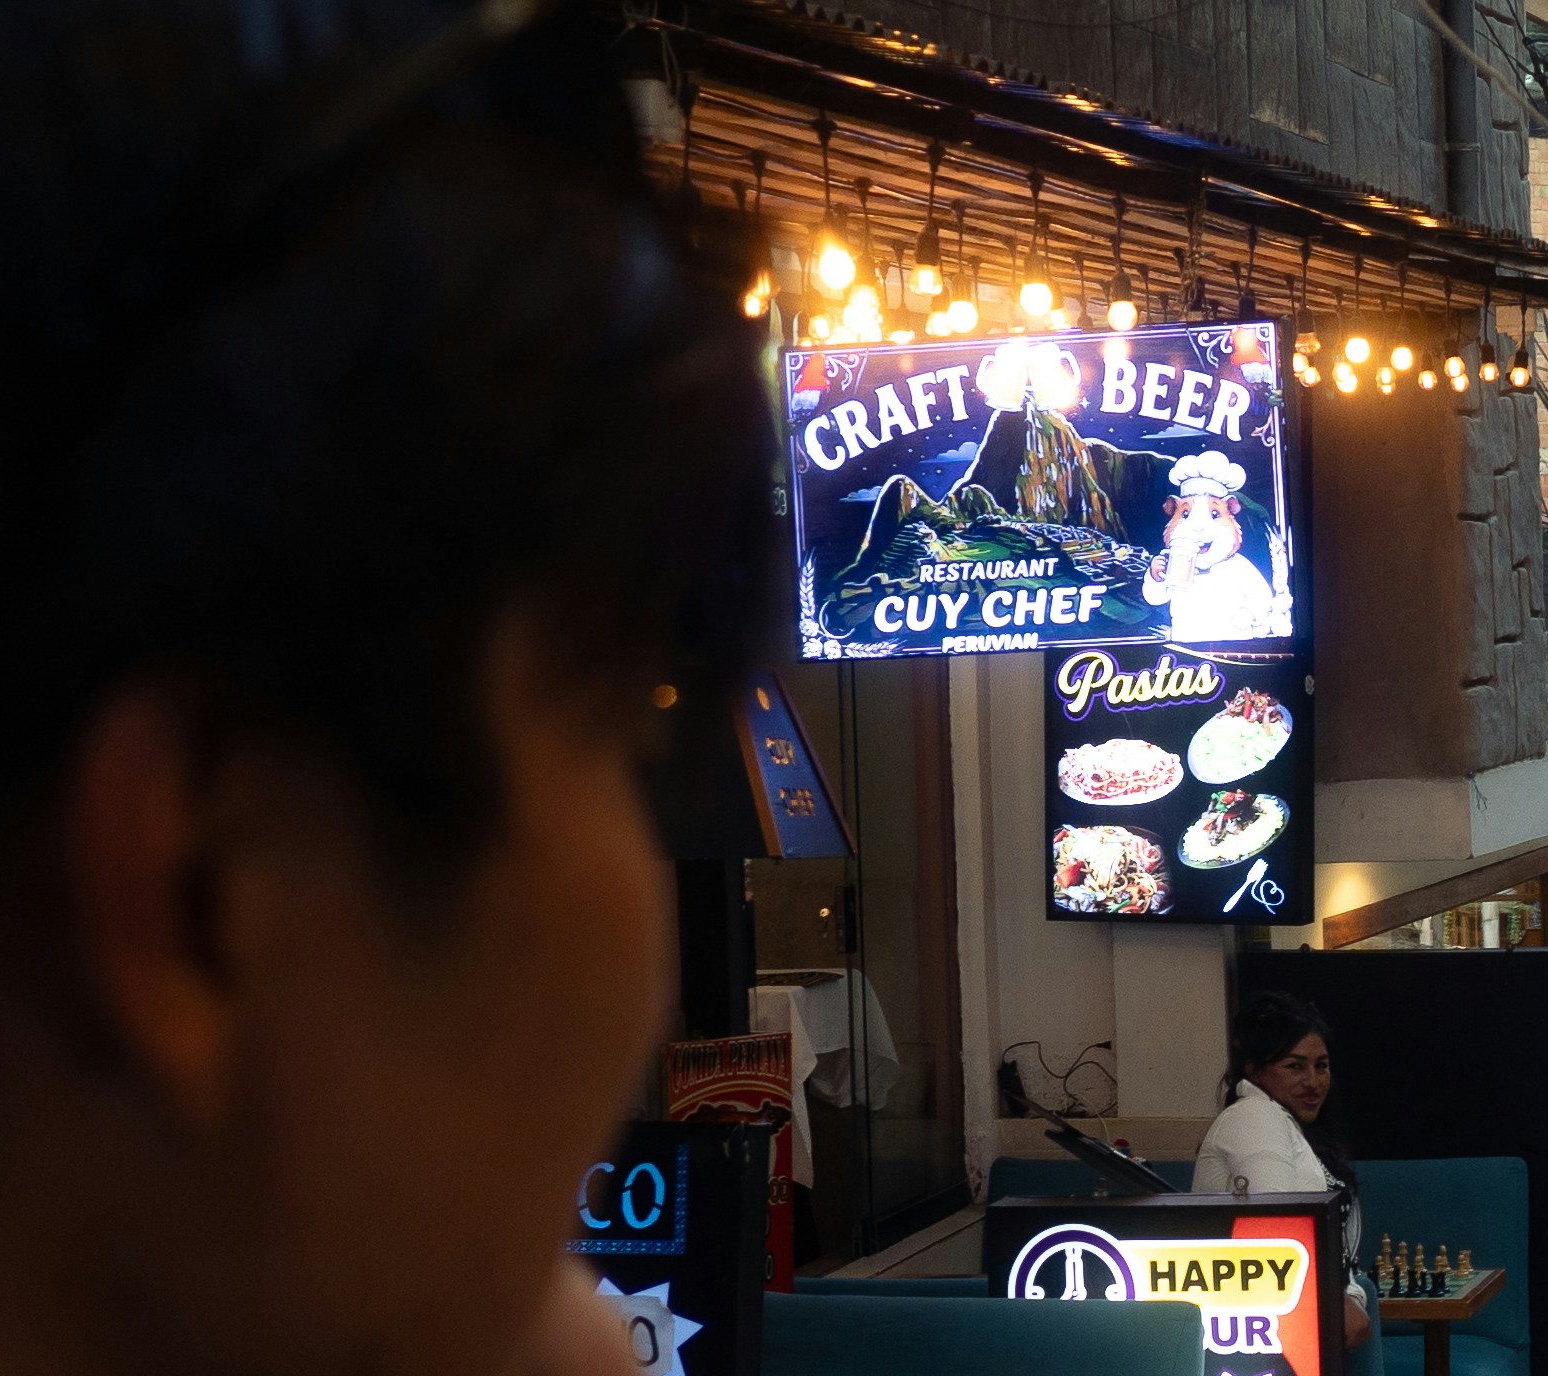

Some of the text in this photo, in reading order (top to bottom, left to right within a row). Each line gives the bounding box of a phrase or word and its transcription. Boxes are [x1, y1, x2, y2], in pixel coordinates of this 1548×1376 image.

[803, 358, 1251, 472] CRAFT BEER
[919, 556, 1060, 584] RESTAURANT
[873, 583, 1108, 634] CUY CHEF
[941, 631, 1039, 654] PERUVIAN
[1056, 652, 1222, 716] Pastas
[574, 1160, 667, 1234] CO
[1149, 1258, 1295, 1293] HAPPY
[1209, 1315, 1274, 1348] UR
